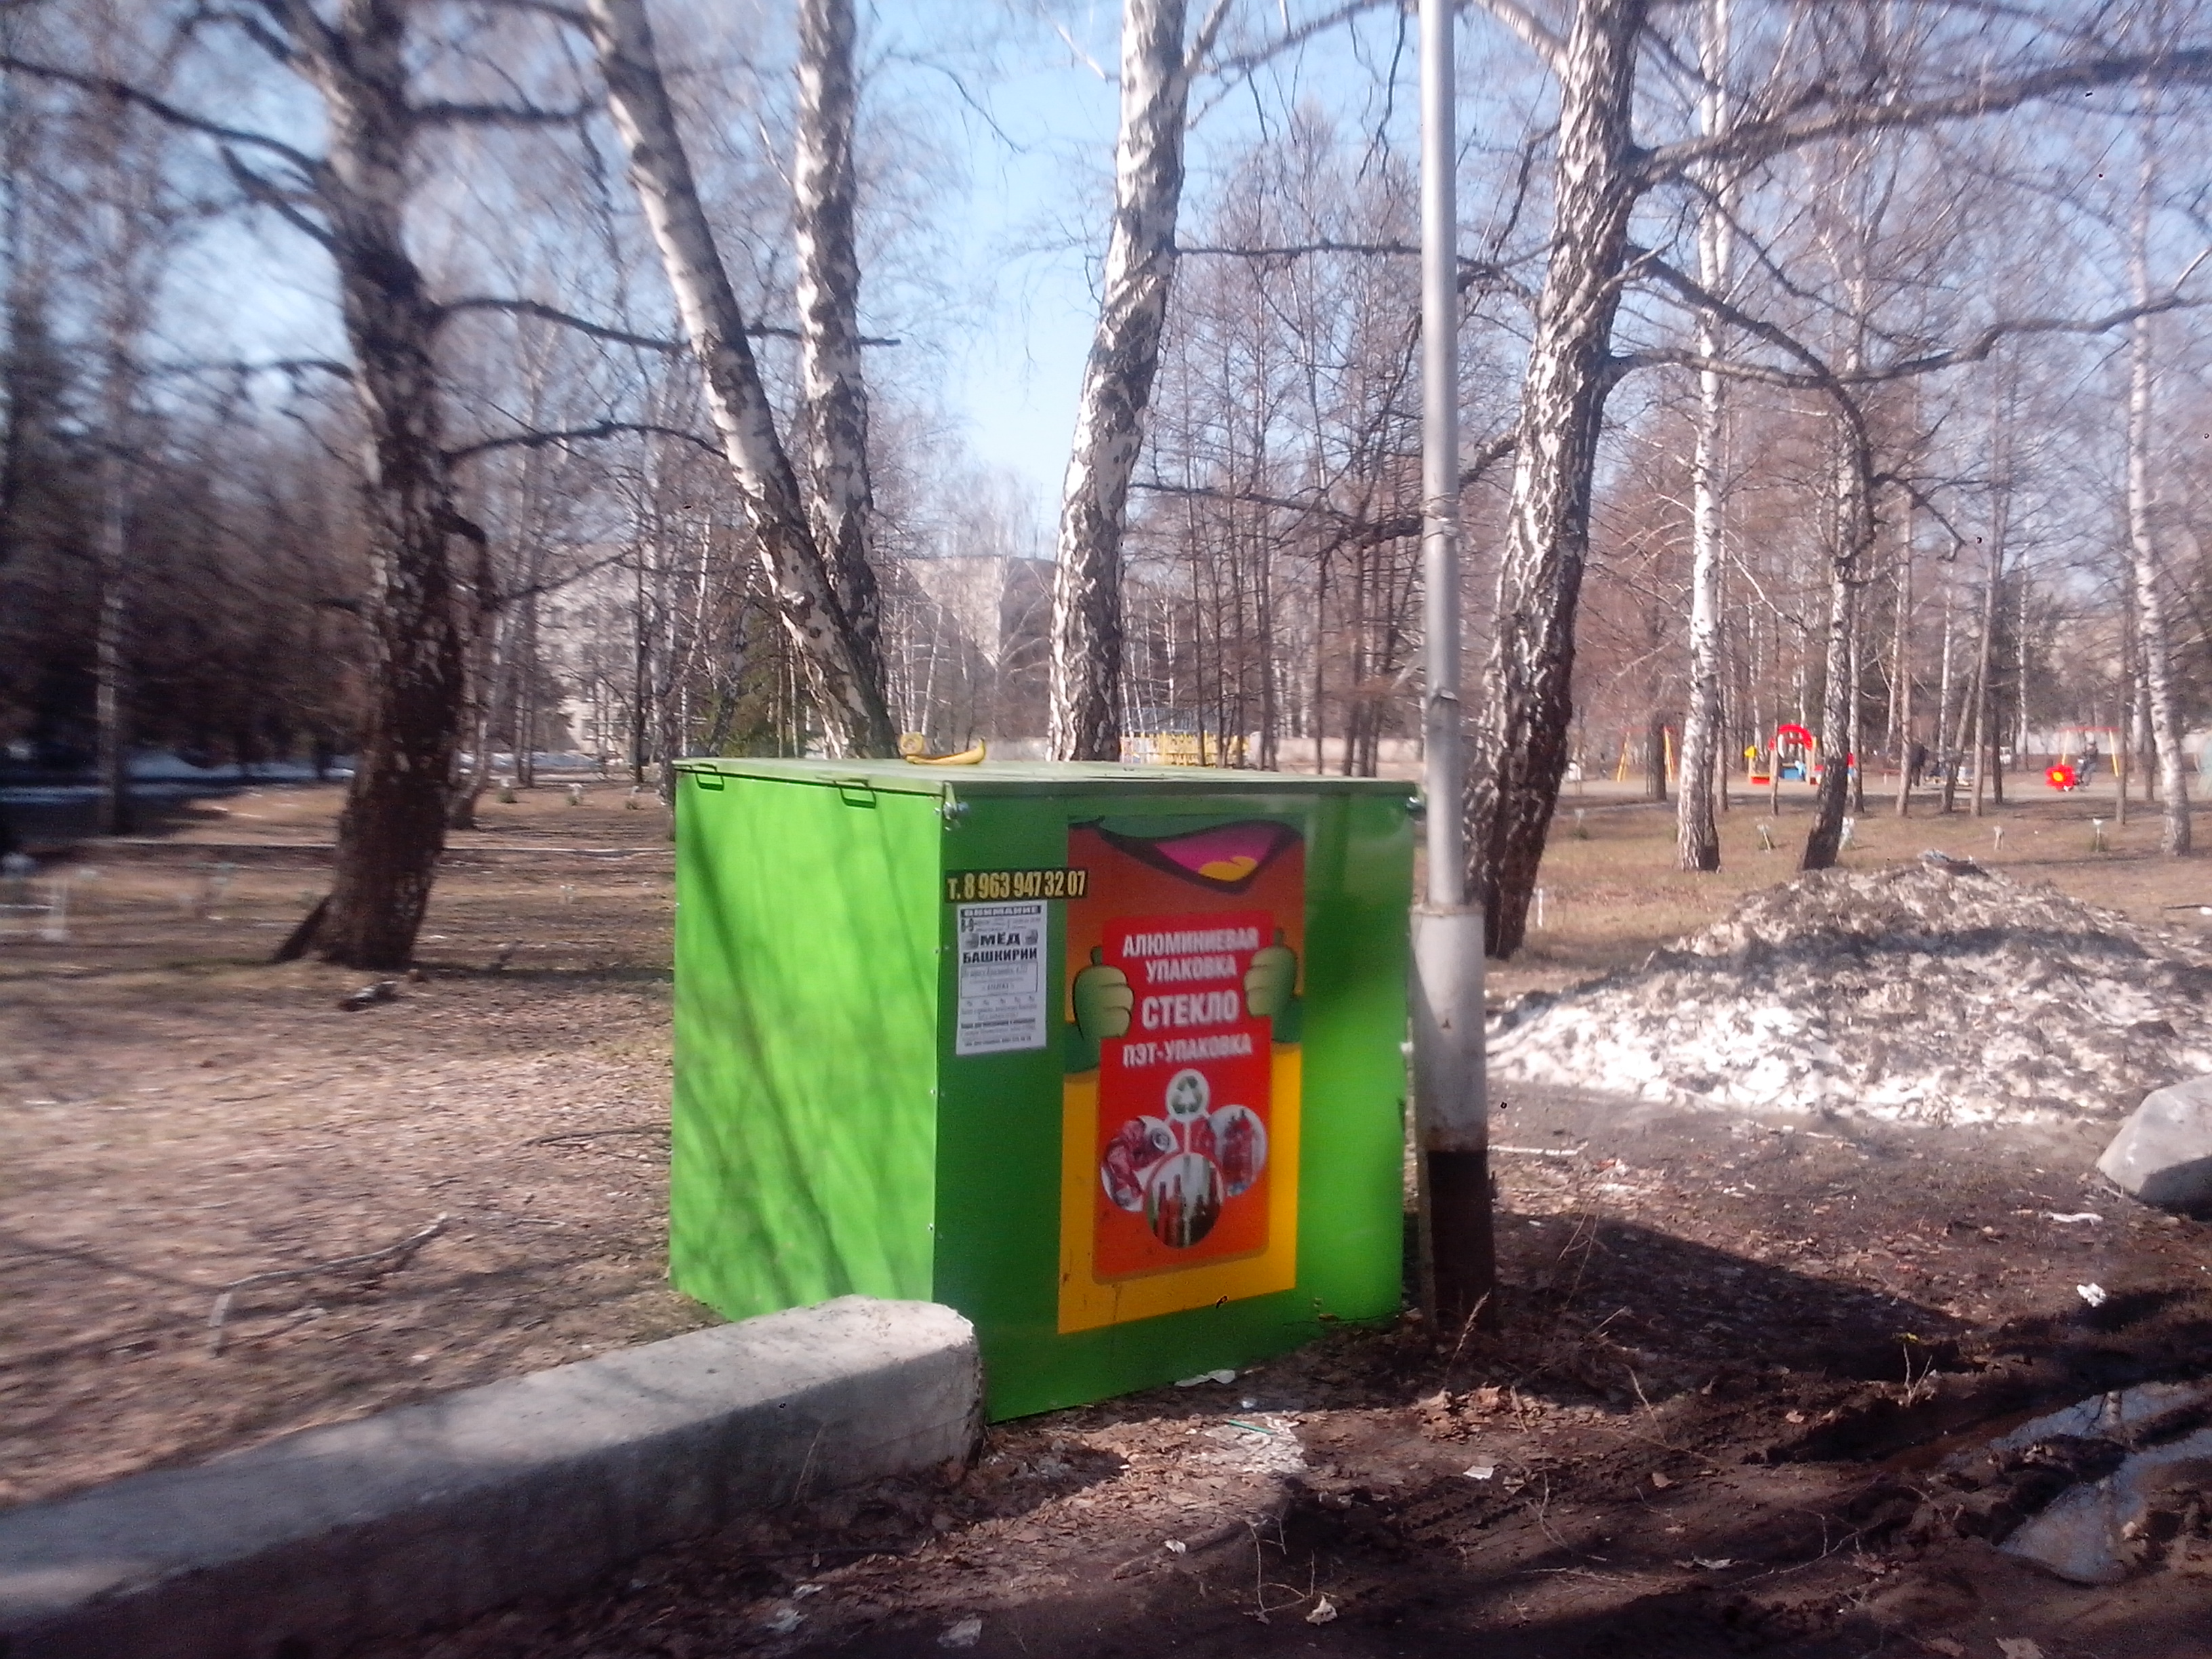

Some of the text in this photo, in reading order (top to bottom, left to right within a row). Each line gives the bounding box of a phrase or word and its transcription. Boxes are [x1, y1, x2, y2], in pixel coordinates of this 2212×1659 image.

[964, 872, 975, 898] 8
[978, 872, 1010, 898] 963
[1014, 871, 1042, 897] 947
[1044, 871, 1064, 897] 32
[1067, 870, 1086, 897] 07
[963, 906, 1039, 917] ВНИМАНИЕ
[963, 947, 1038, 964] БАШКИРИИ
[1123, 927, 1259, 957] АЛЮМИНИЕВАЯ
[1145, 954, 1237, 984] УПАКОВКА
[1142, 989, 1240, 1030] СТЕКЛО
[1122, 1033, 1252, 1068] ПЭТ-УПАКОВКА
